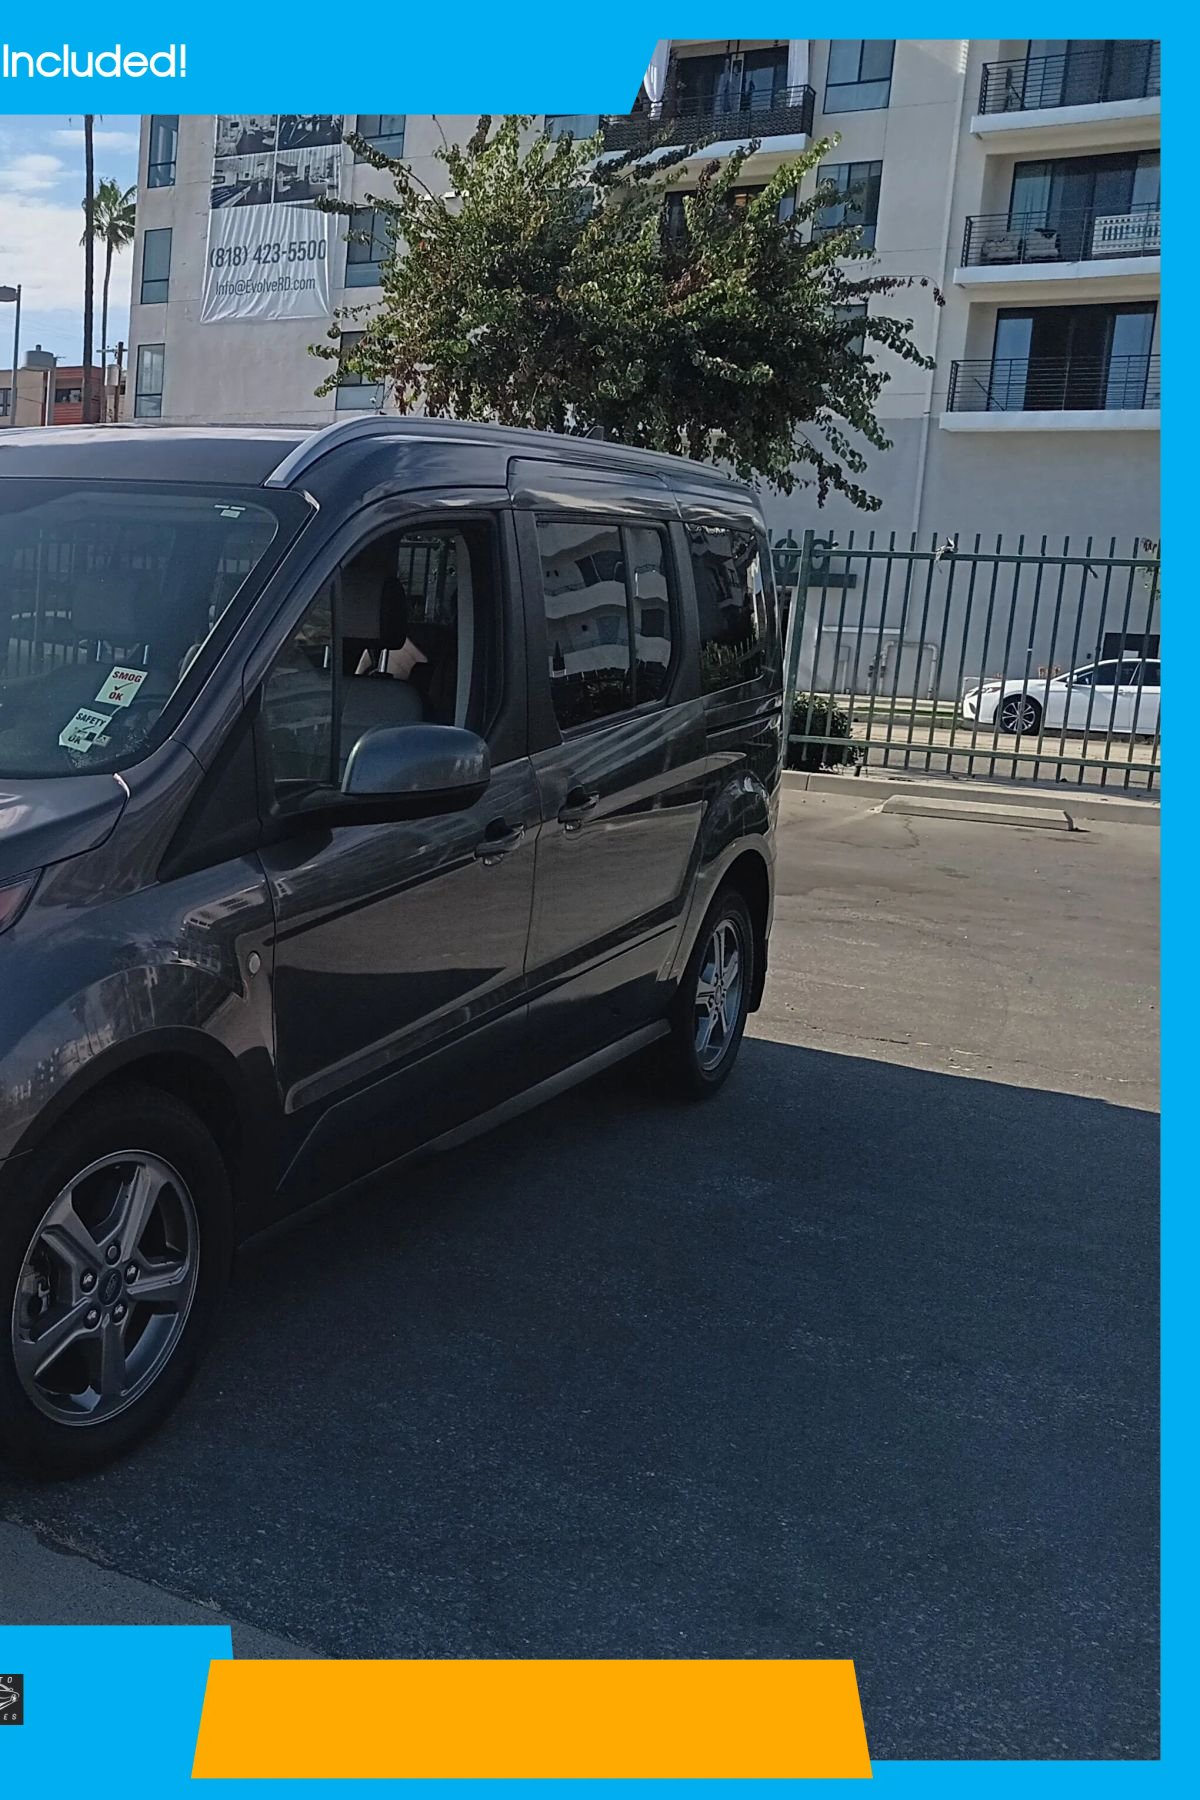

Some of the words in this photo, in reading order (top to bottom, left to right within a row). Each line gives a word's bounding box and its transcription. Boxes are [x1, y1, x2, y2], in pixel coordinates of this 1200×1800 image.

[210, 245, 248, 267] (818)
[253, 239, 326, 265] 423-5500
[216, 277, 316, 296] Info@EvolveRD.com
[112, 671, 142, 683] SMOG
[108, 692, 124, 701] OK
[75, 712, 107, 728] SAFETY
